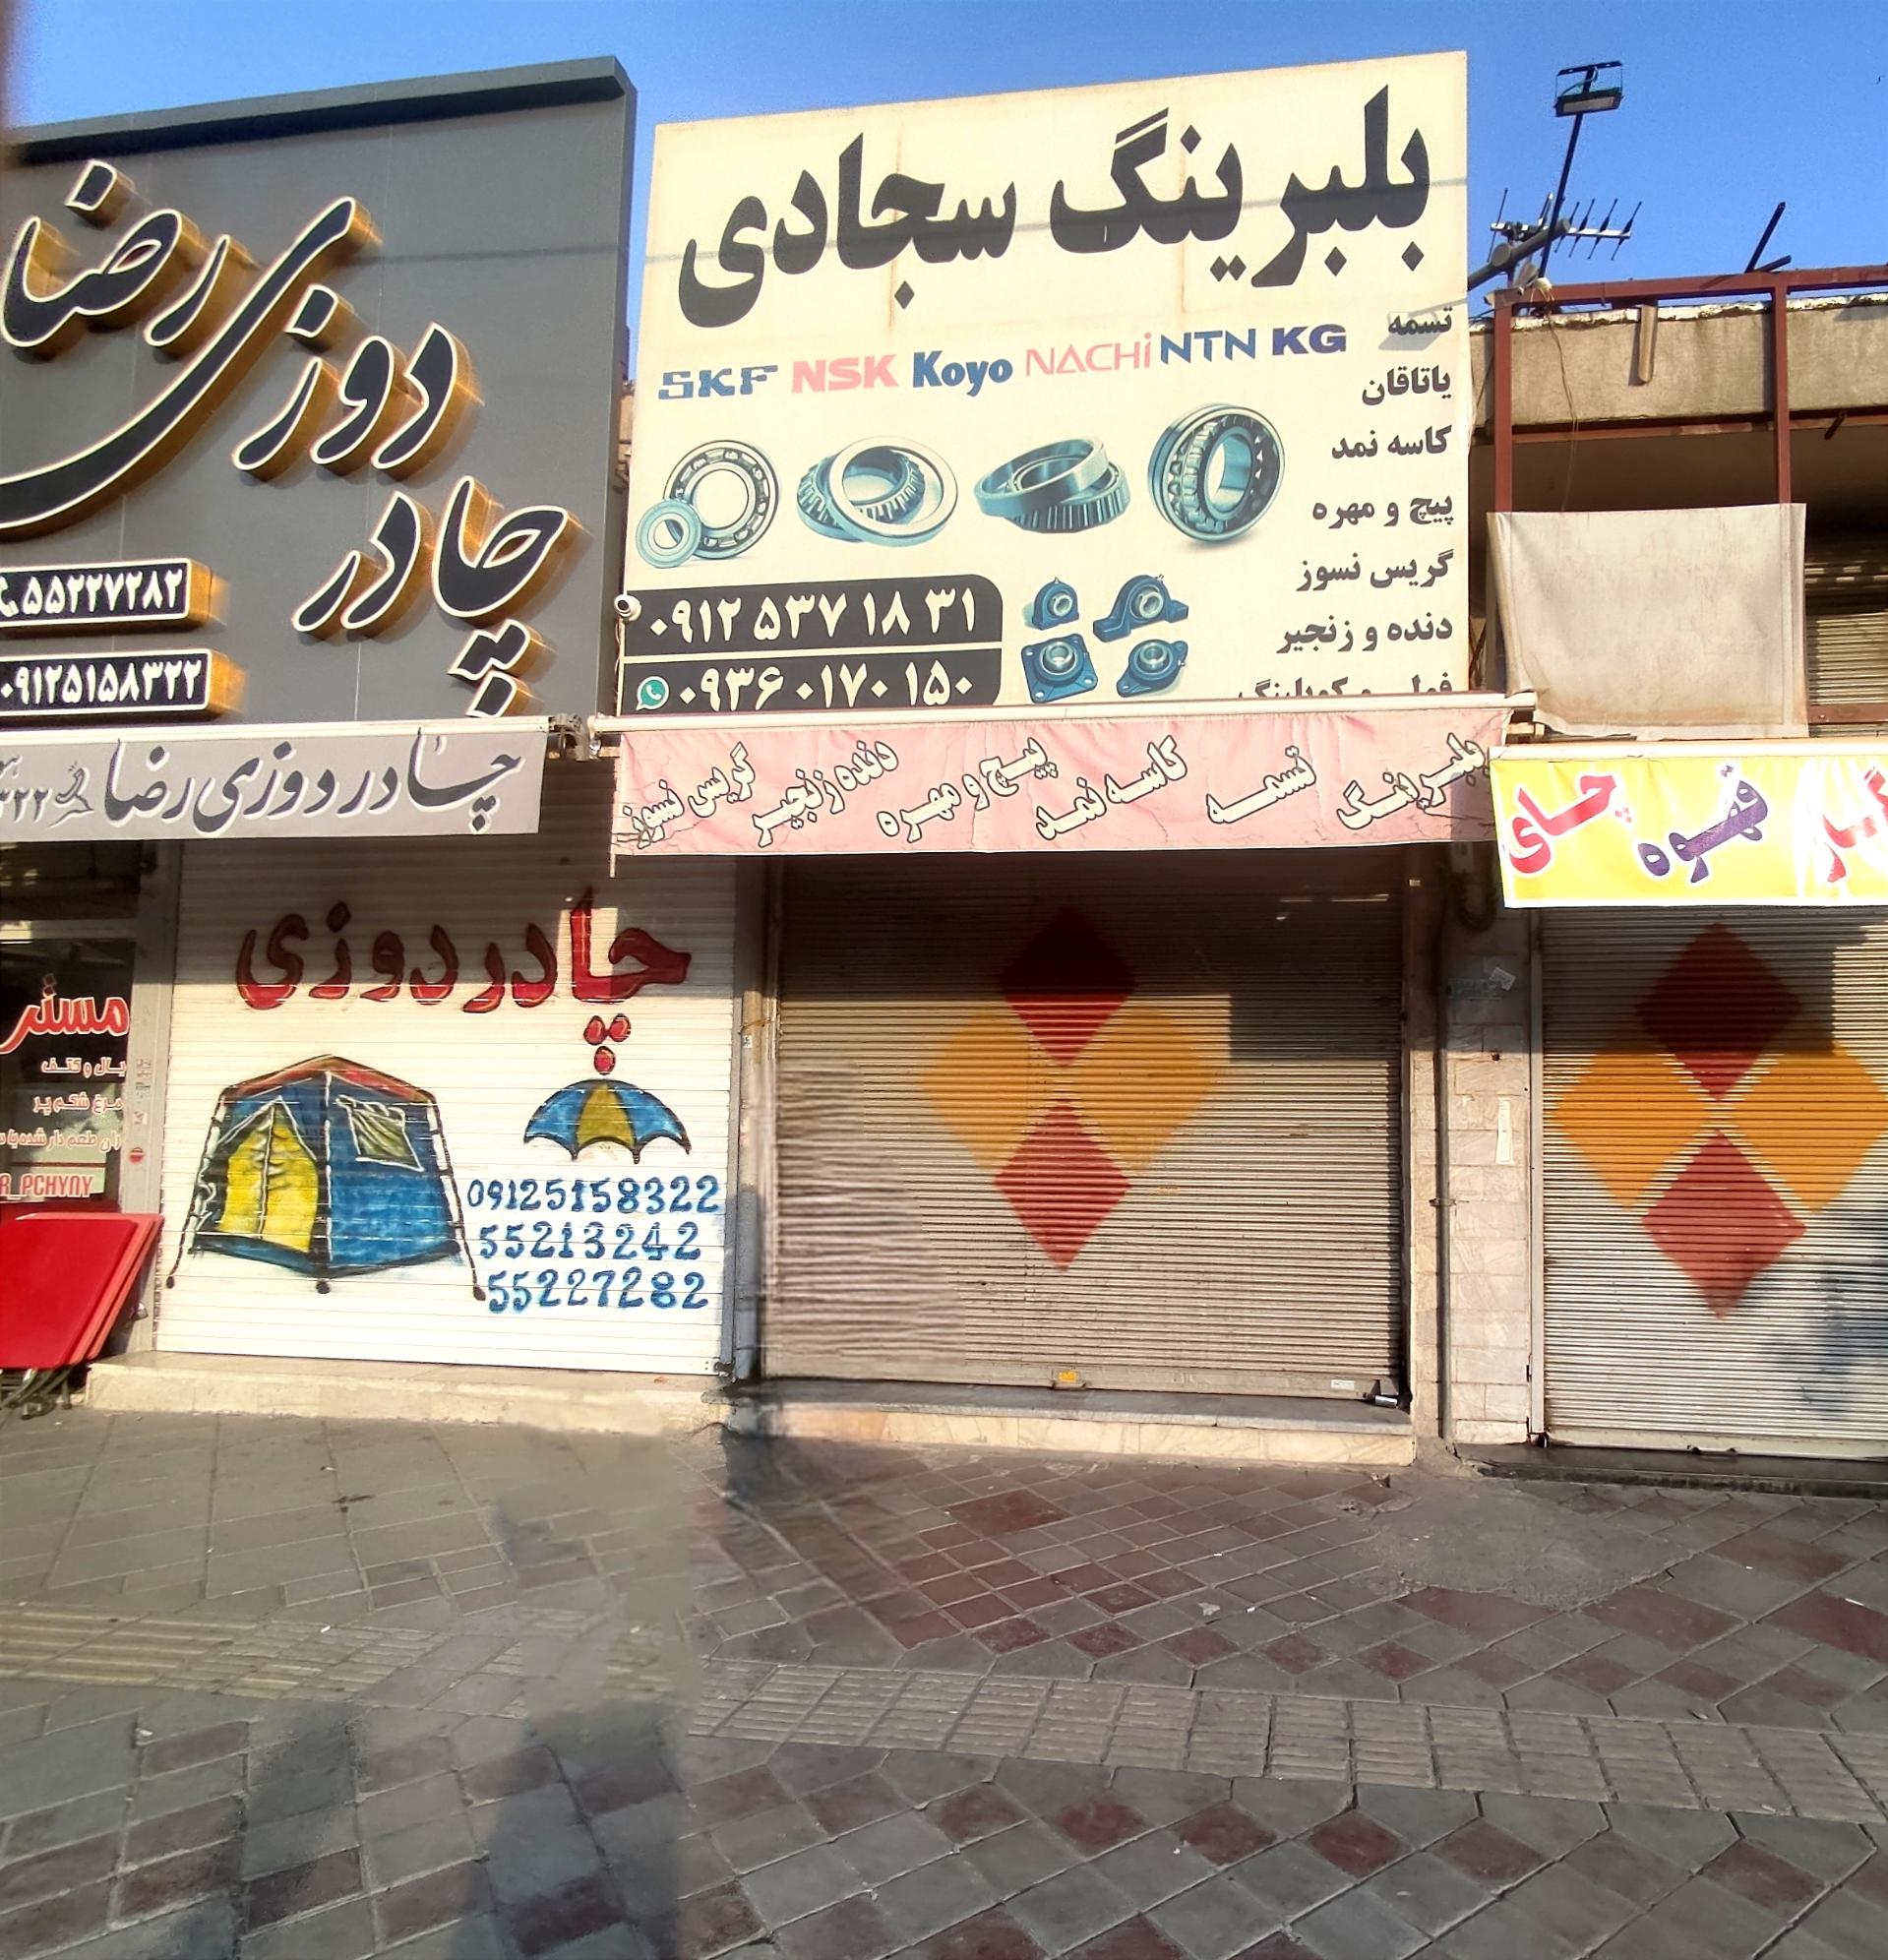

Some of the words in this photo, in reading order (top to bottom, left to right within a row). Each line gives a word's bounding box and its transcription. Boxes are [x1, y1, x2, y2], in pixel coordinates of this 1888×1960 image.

[1049, 84, 1431, 288] بلبرینگ
[1, 159, 232, 347] رضا
[678, 133, 1017, 329] سجادی
[1388, 307, 1452, 336] تسمه
[0, 197, 458, 530] دوزی
[658, 365, 778, 400] SKF
[791, 353, 897, 394] NSK
[912, 350, 1013, 398] Koyo
[1160, 327, 1256, 367] NTN
[1271, 324, 1347, 357] KG
[1362, 365, 1451, 405] یاتاقان
[1331, 430, 1378, 459] نمد
[1387, 425, 1452, 455] کاسه
[1312, 498, 1374, 529] مهره
[1384, 502, 1399, 526] و
[1409, 494, 1453, 524] پیچ
[22, 568, 183, 615] ۵۵۲۲۷۲۸۲
[1297, 552, 1361, 591] نسوز
[1370, 548, 1454, 588] گریس
[292, 475, 571, 719] چادر
[650, 597, 742, 643] ۰۹۱۲
[753, 593, 847, 641] ۵۳۷
[863, 590, 910, 636] ۱۸
[925, 587, 975, 634] ۳۱
[1276, 615, 1354, 653] زنجیر
[1362, 626, 1377, 651] و
[1387, 612, 1453, 642] دنده
[1, 659, 202, 705] ۰۹۱۲۵۱۵۸۳۲۲
[679, 665, 784, 711] ۰۹۳۶
[796, 662, 888, 708] ۰۱۷۰
[905, 660, 973, 705] ۱۵۰
[104, 739, 193, 826] رضا
[689, 741, 756, 818] گریس
[834, 740, 898, 791] دنده
[979, 737, 1058, 797] پیچ
[1104, 735, 1188, 804] کاسه
[1206, 745, 1316, 824] تسمه
[623, 779, 685, 849] نسوز
[752, 768, 845, 848] زنجیر
[877, 782, 961, 843] مهره
[962, 773, 990, 811] و
[1036, 776, 1108, 840] نمد
[1509, 775, 1633, 874] چای
[1637, 765, 1769, 884] قهوه
[83, 1062, 92, 1078] و
[93, 1057, 127, 1077] بال
[467, 1175, 719, 1214] 09125158322
[479, 1221, 700, 1260] 55213242
[488, 1266, 708, 1313] 55227282
